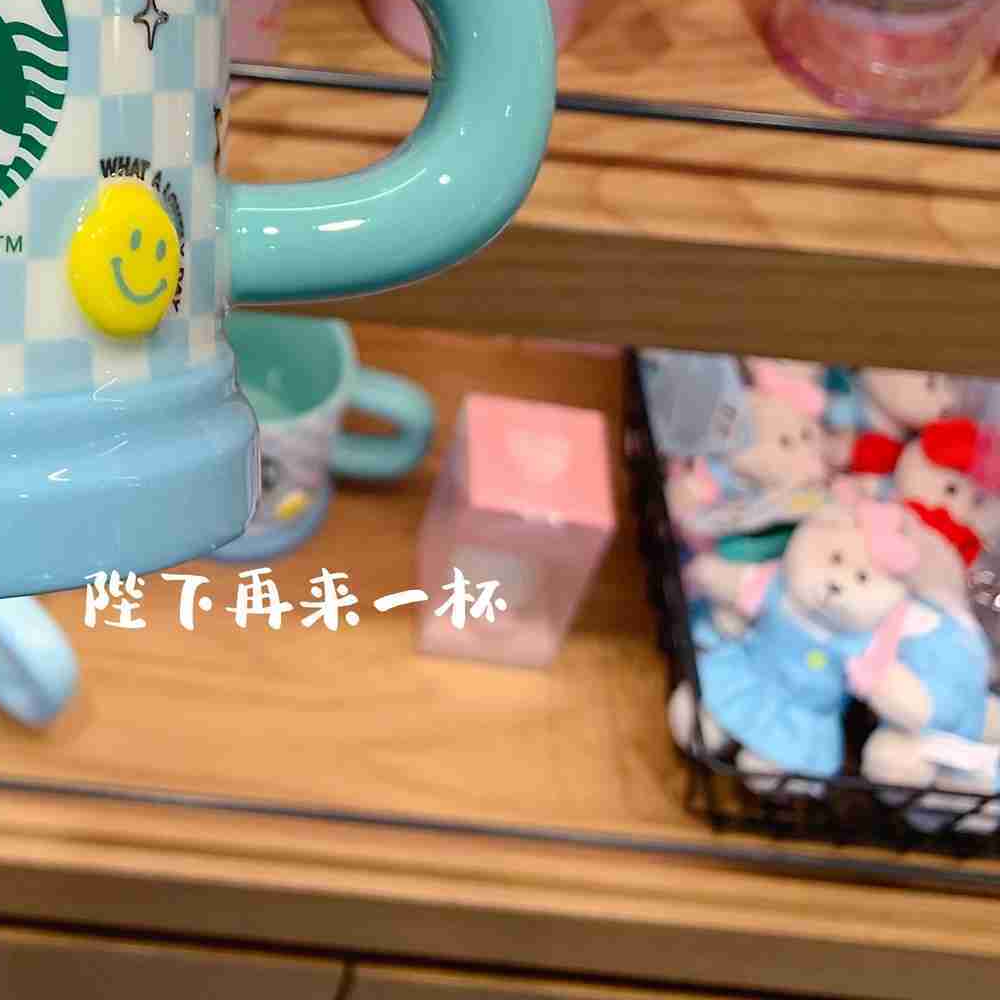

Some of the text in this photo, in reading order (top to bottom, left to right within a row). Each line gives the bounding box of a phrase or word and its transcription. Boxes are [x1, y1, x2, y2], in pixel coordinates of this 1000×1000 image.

[100, 155, 151, 181] WHAT
[151, 170, 162, 192] A
[171, 267, 185, 312] DAY
